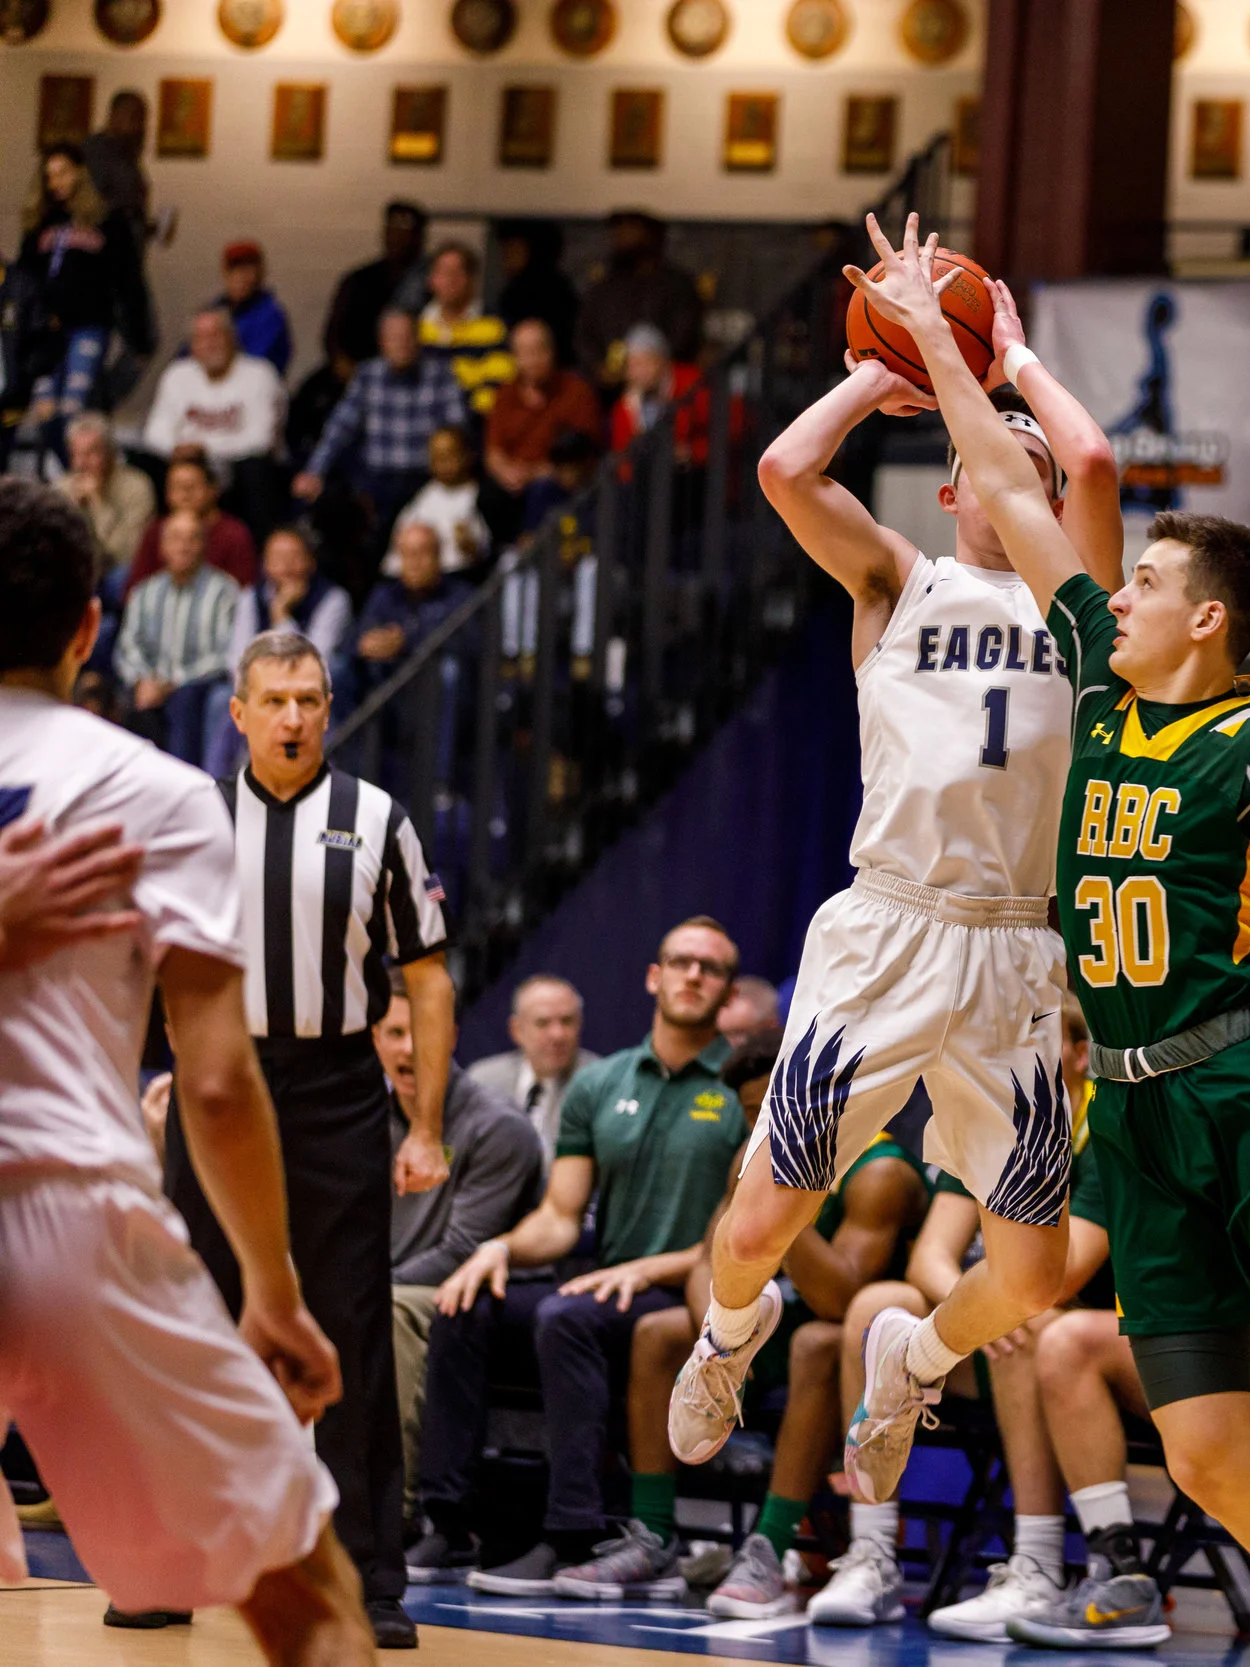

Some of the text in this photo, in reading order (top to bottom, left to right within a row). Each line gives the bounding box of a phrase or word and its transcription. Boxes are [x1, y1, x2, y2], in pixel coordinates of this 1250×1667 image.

[978, 686, 1011, 770] 1
[1077, 779, 1182, 861] RBC
[1075, 875, 1170, 988] 30
